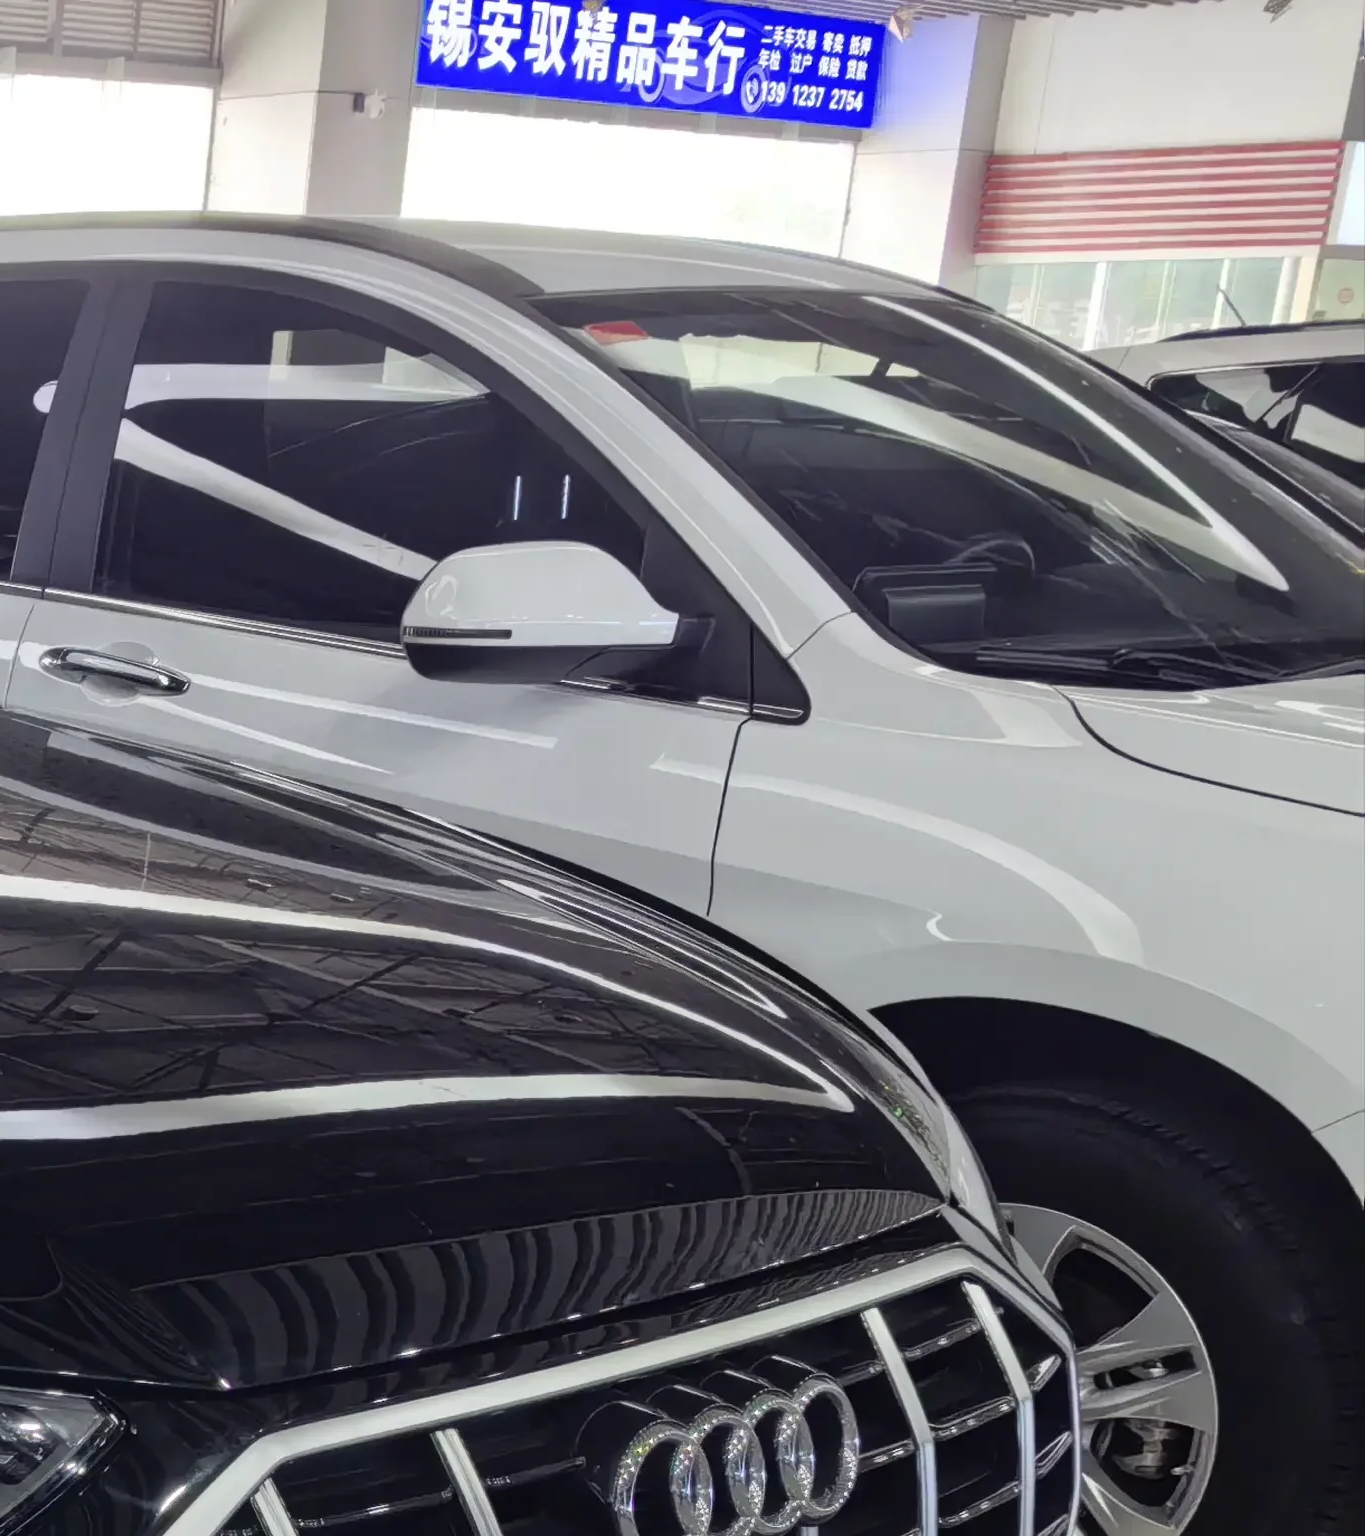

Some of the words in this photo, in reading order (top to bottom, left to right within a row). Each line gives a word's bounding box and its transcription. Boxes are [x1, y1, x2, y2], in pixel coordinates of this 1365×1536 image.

[427, 0, 745, 95] 锡安驭精品车行
[761, 25, 817, 51] 二手车交易
[758, 48, 781, 71] 年检
[789, 52, 813, 74] 过户
[761, 81, 785, 104] 139
[792, 84, 826, 108] 1237
[829, 87, 864, 112] 2754
